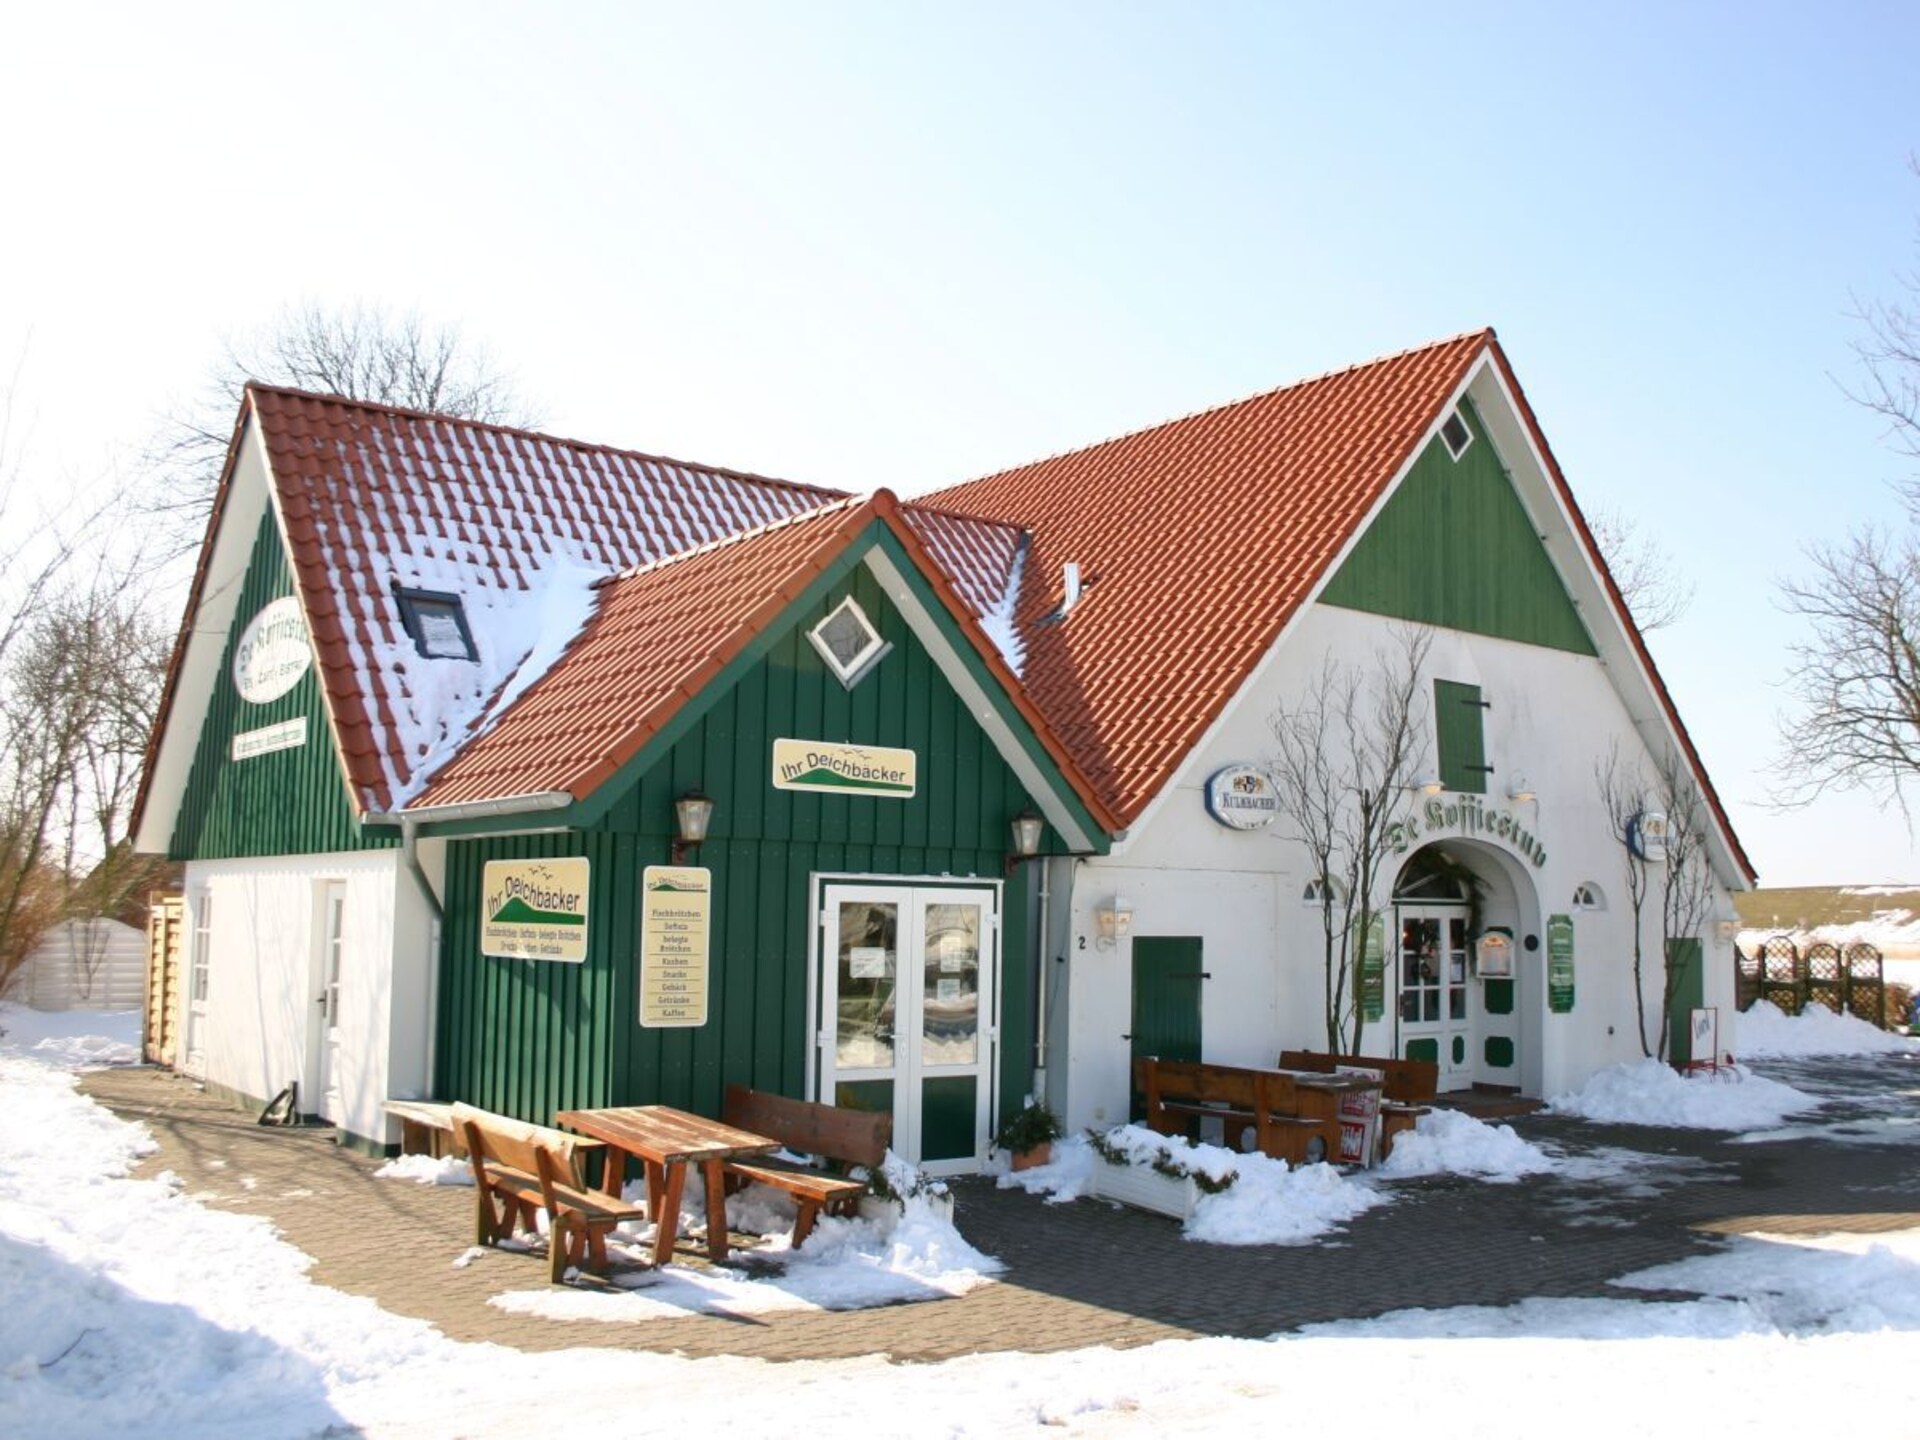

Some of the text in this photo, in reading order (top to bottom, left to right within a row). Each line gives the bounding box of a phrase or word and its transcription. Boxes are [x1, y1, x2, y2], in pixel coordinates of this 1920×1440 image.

[780, 752, 907, 782] Ihr Deichbäcker
[487, 873, 581, 917] Ihr Deichbäcker
[1078, 935, 1086, 950] 2
